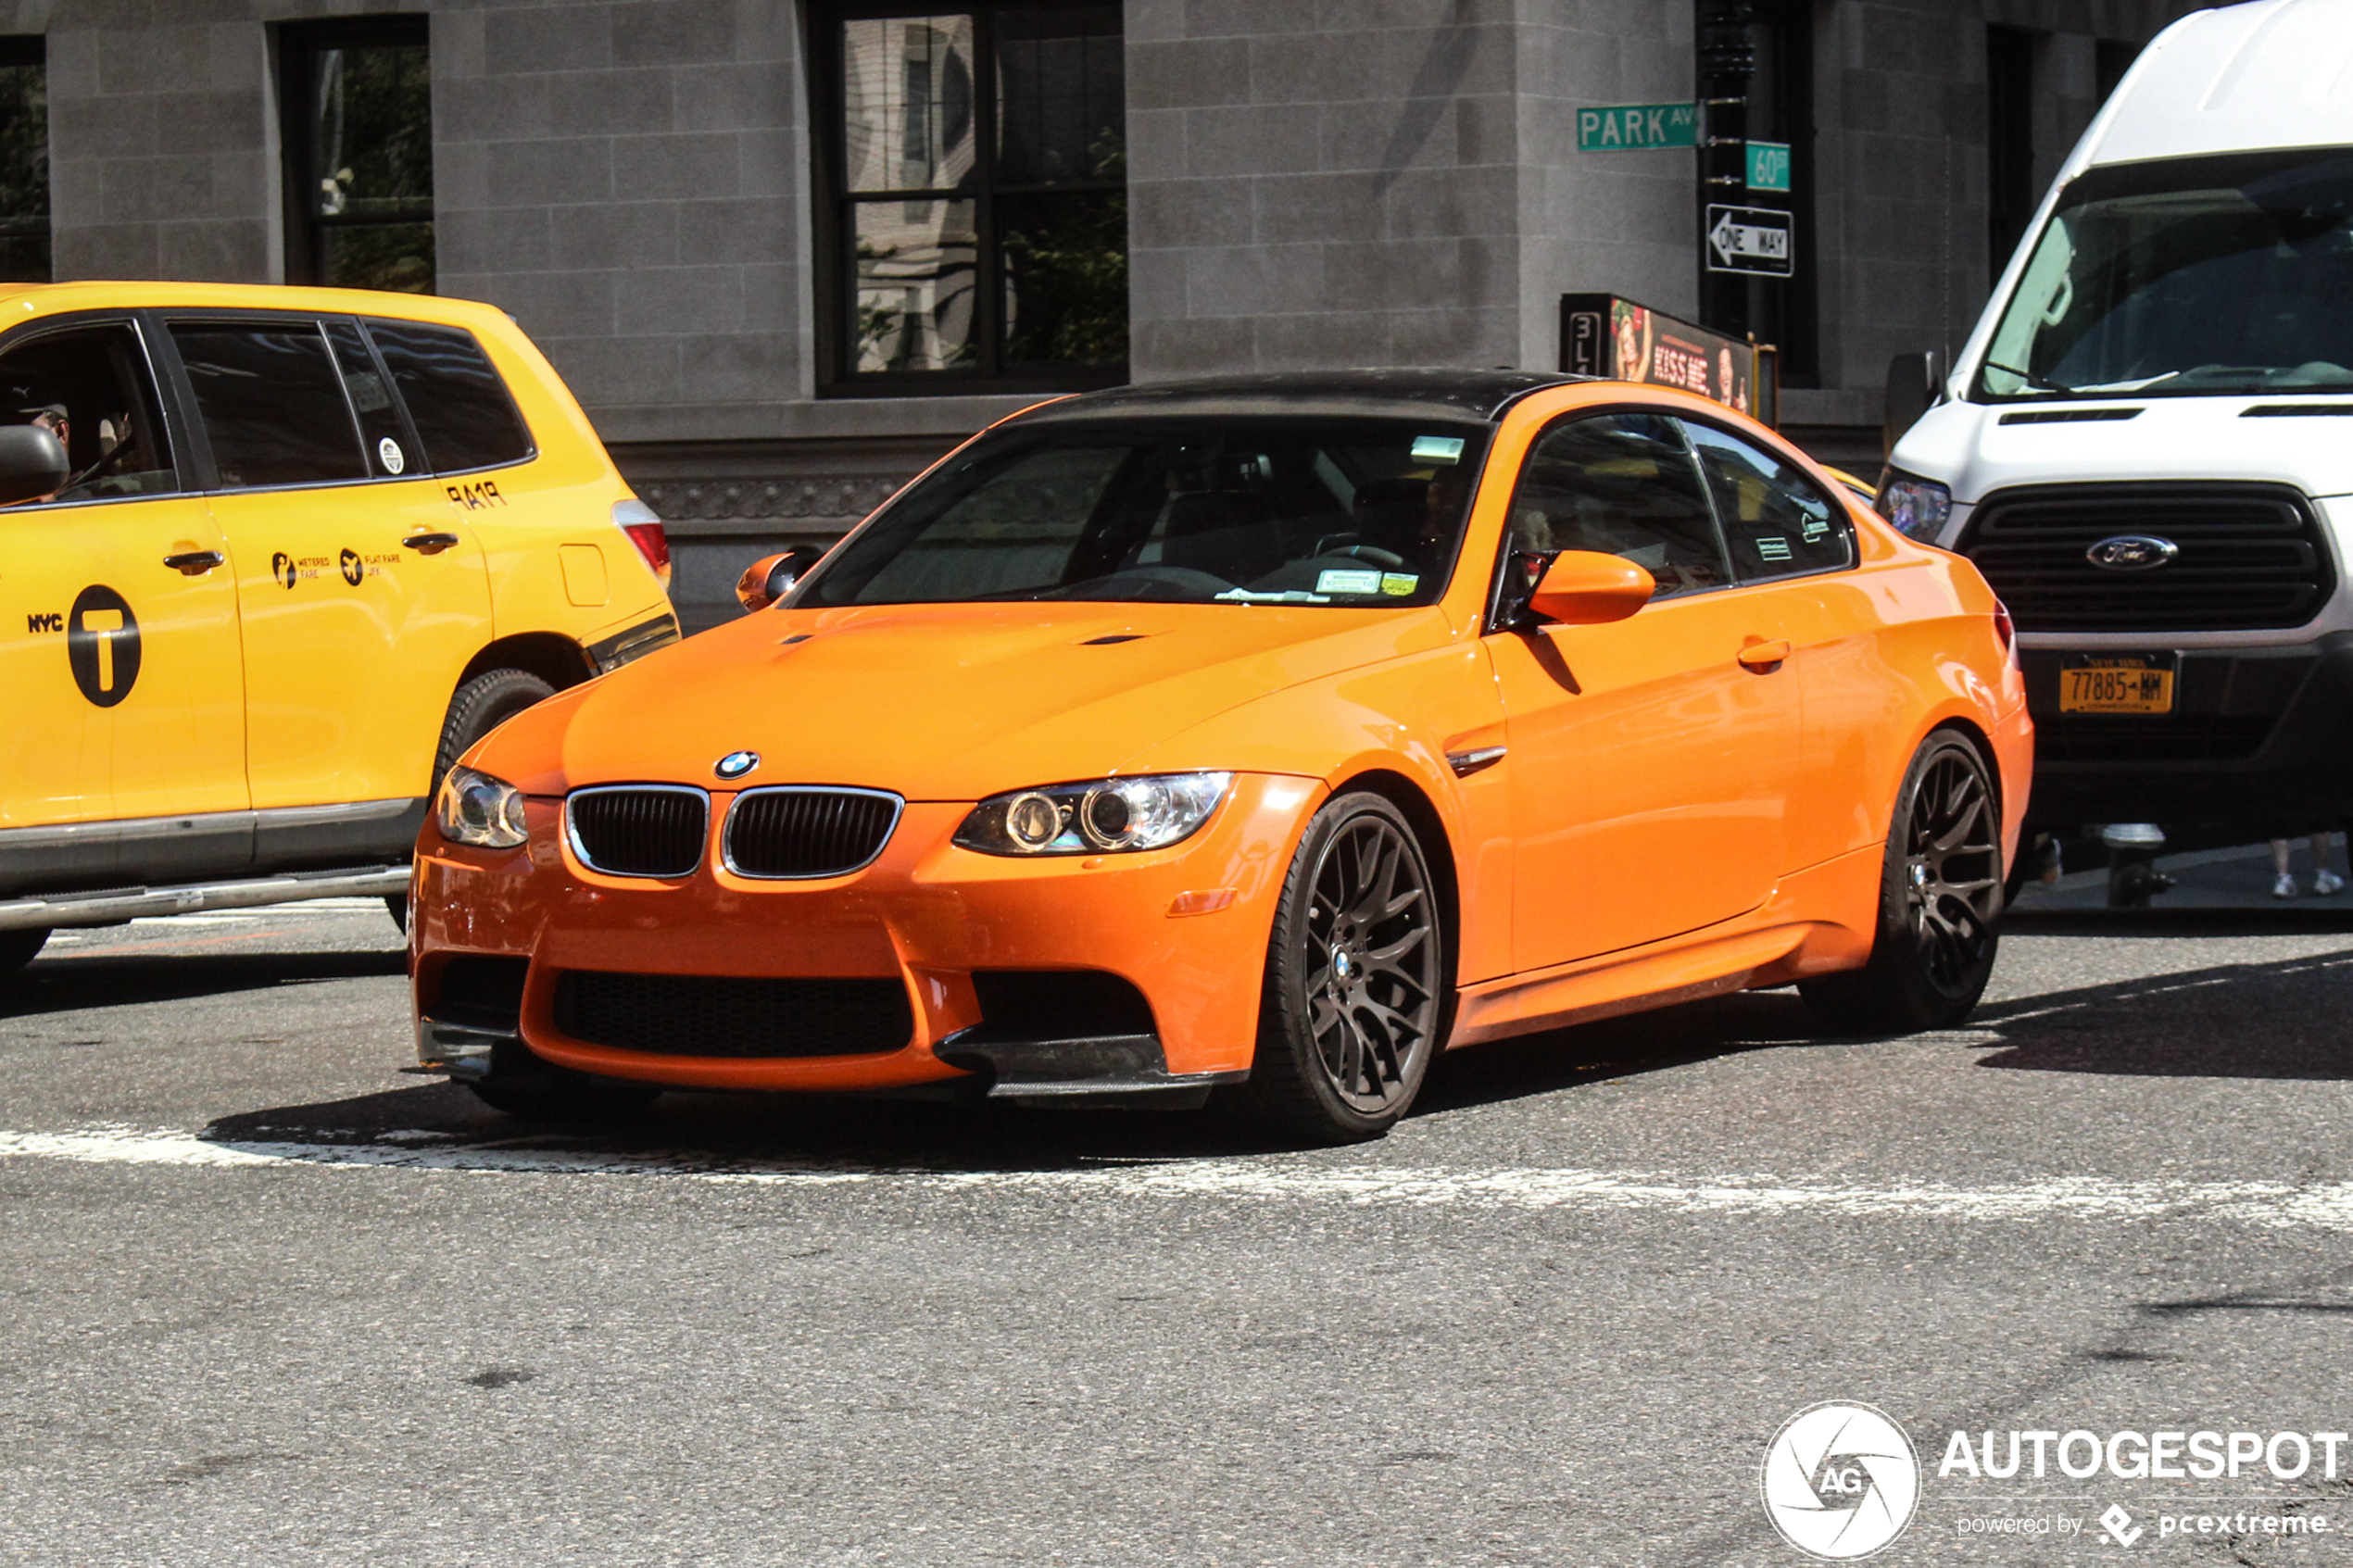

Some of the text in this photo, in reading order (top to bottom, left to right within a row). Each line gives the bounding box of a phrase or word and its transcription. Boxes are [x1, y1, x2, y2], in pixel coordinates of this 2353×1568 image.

[1580, 110, 1667, 146] PARK
[1719, 226, 1785, 256] ONE WAY
[1655, 345, 1687, 386] KISS
[447, 481, 508, 511] 9A19
[297, 557, 330, 567] METERED
[300, 569, 319, 579] FARE
[365, 554, 401, 564] FLAT FARE
[28, 613, 64, 633] NYC
[82, 608, 124, 692] T
